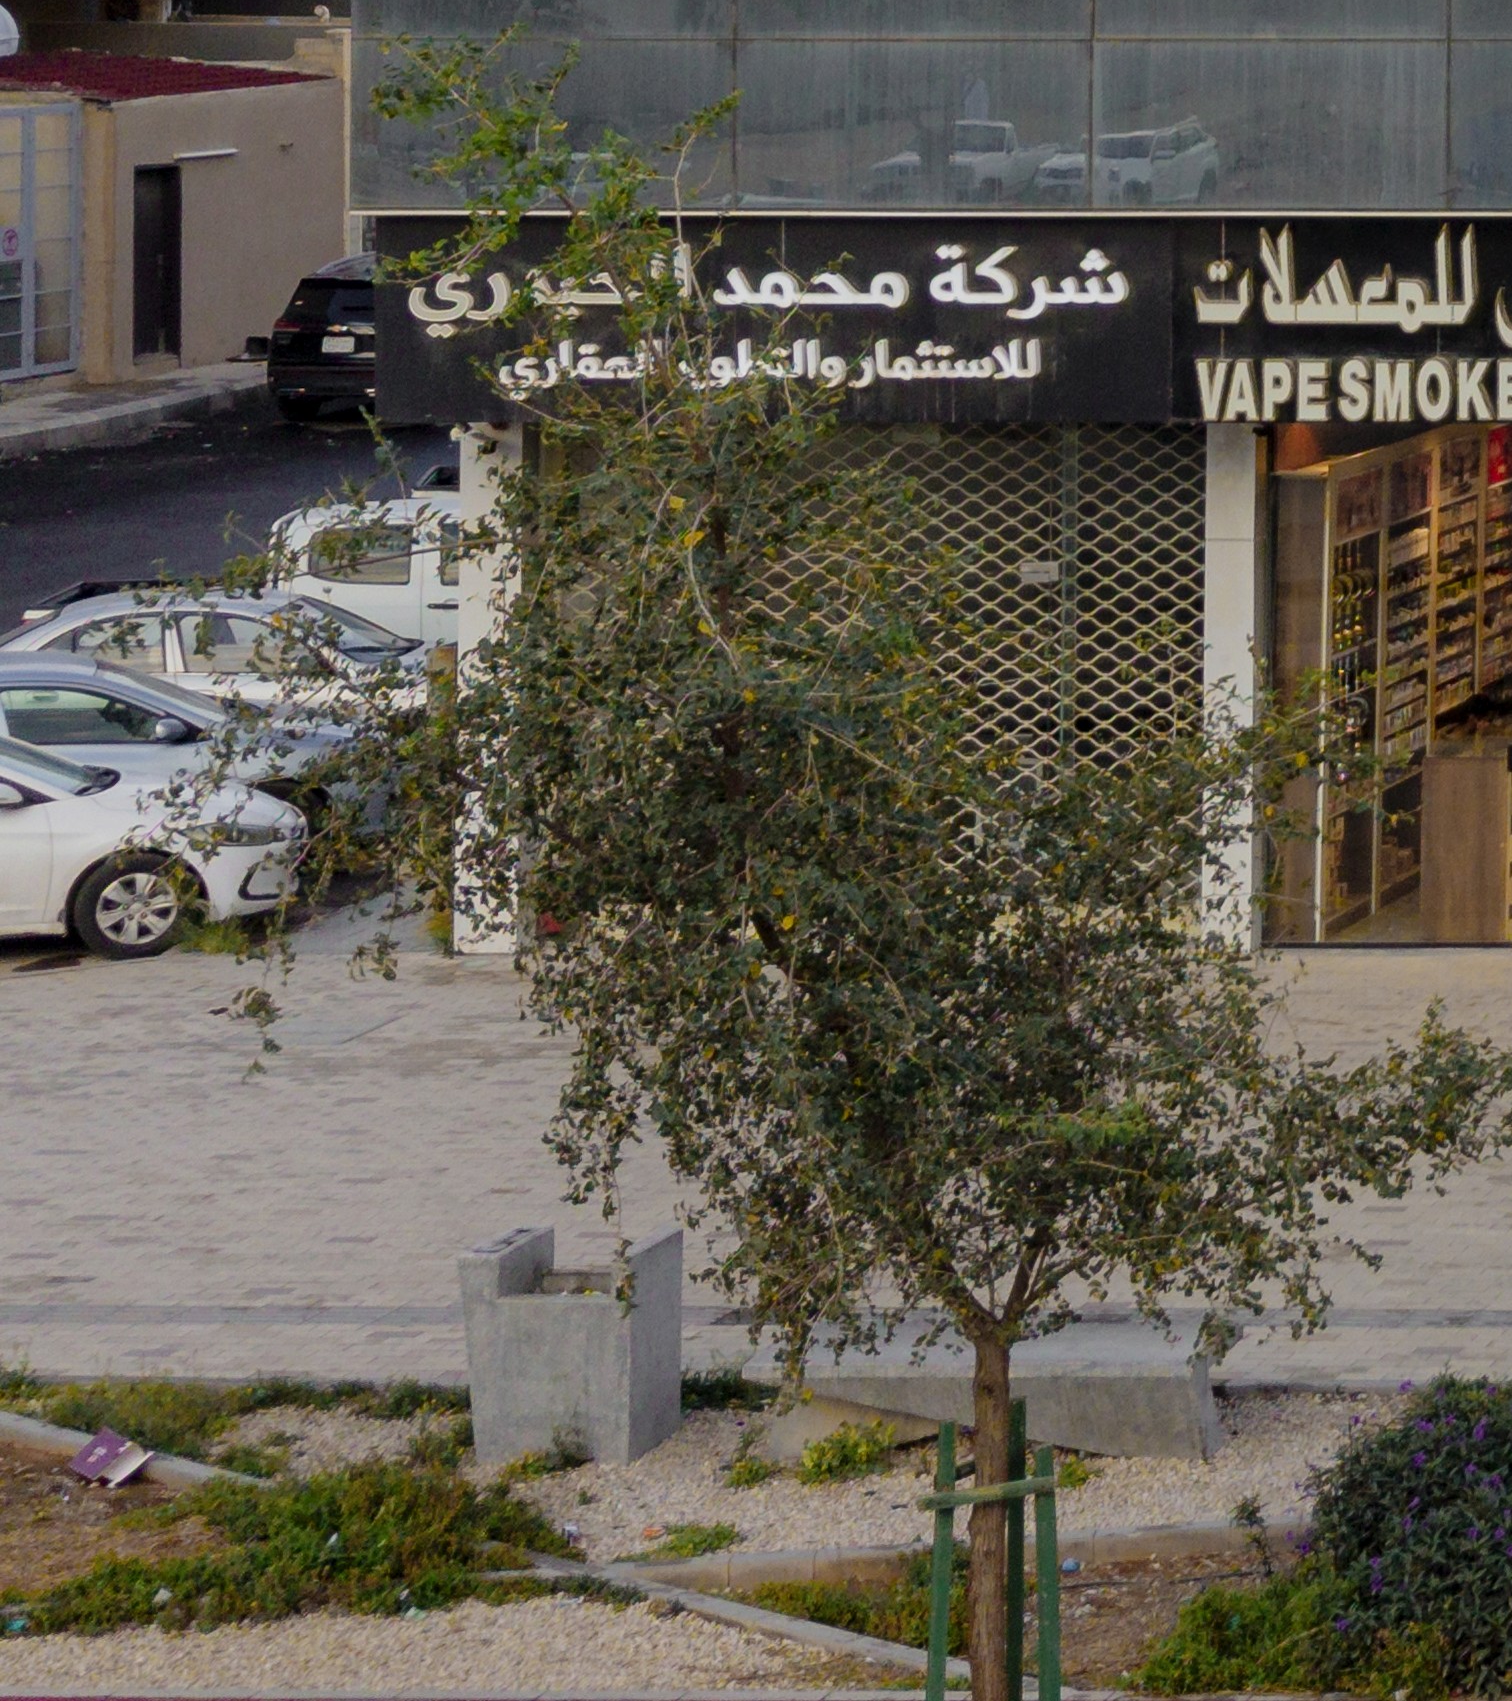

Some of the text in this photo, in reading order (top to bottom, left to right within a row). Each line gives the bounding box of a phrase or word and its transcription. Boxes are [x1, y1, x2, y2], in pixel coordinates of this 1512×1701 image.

[713, 266, 910, 309] محمد
[929, 243, 1130, 319] شركة
[1193, 222, 1477, 333] للمعسلات
[677, 337, 848, 391] والتطو
[847, 337, 1042, 389] للاستثمار
[1195, 357, 1331, 422] VAPE
